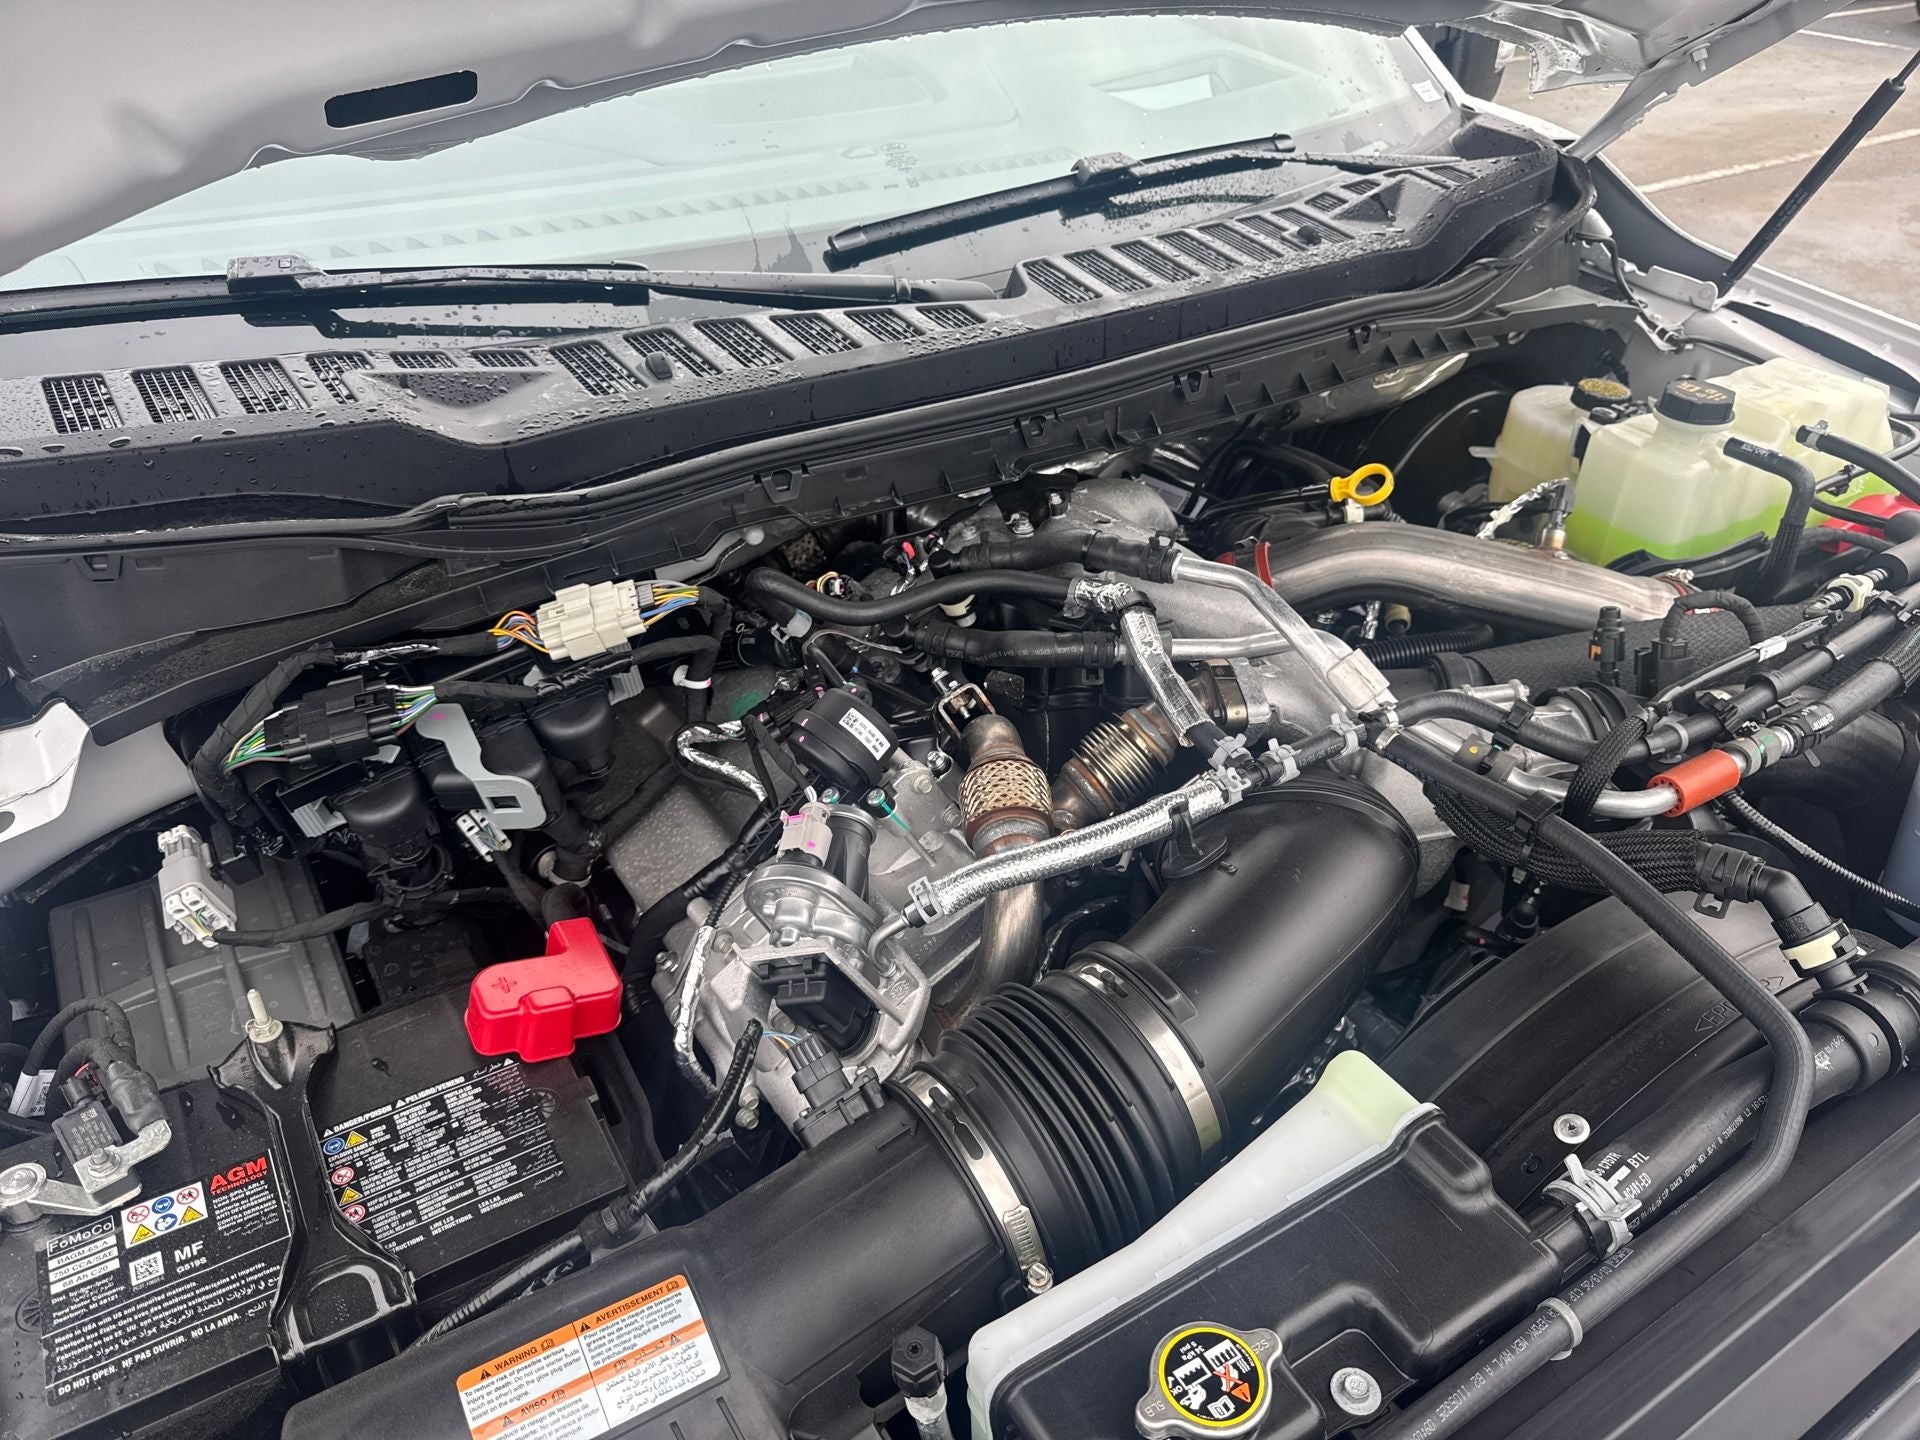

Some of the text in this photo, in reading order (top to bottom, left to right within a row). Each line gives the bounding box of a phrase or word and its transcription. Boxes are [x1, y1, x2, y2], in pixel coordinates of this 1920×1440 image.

[333, 1104, 392, 1132] DANGER/POISON
[404, 1075, 465, 1104] PELIGRO/VENENO
[1626, 1147, 1649, 1170] BTL
[210, 1156, 268, 1191] AGM
[211, 1168, 267, 1197] TECHNOLOGY
[212, 1178, 265, 1205] NON-SPILLABLE
[213, 1182, 268, 1209] Lead Acid Battery
[216, 1211, 230, 1220] ANTI
[217, 1198, 276, 1227] CONTRA DERRAMES
[49, 1217, 111, 1254] FoMoCo
[53, 1248, 114, 1279] 750 CCA/SAE
[57, 1238, 108, 1266] BAGM-65-A
[173, 1239, 204, 1263] MF
[62, 1263, 108, 1287] 68 Ah C20
[52, 1306, 69, 1318] Ford
[70, 1298, 90, 1310] Motor
[54, 1331, 73, 1344] Made
[82, 1321, 96, 1332] USA
[97, 1315, 111, 1326] with
[112, 1310, 122, 1319] US
[123, 1305, 135, 1314] and
[136, 1291, 165, 1310] imported
[89, 1302, 98, 1310] MI
[134, 1310, 148, 1320] avec
[150, 1304, 161, 1313] des
[584, 1330, 598, 1340] Pour
[598, 1320, 619, 1333] réduire
[626, 1308, 646, 1321] risque
[653, 1291, 681, 1307] blessures
[594, 1287, 664, 1323] AVERTISSEMENT
[93, 1338, 102, 1347] en
[103, 1333, 113, 1342] los
[139, 1318, 151, 1328] con
[586, 1334, 606, 1347] graves
[663, 1302, 674, 1310] pas
[587, 1340, 606, 1353] fluides
[606, 1336, 615, 1344] de
[614, 1322, 645, 1341] démarrage
[590, 1350, 604, 1359] avec
[612, 1336, 632, 1349] moteur
[659, 1312, 682, 1327] bougies
[58, 1310, 241, 1396] DO NOT OPEN. NE PAS OUVRIR. NO LA ABRA.
[494, 1345, 537, 1371] WARNING
[1181, 1344, 1204, 1362] 34 kPa
[464, 1346, 565, 1398] To reduce risk of possible serious
[466, 1393, 485, 1406] injury
[493, 1379, 513, 1392] death:
[513, 1374, 523, 1383] Do
[523, 1369, 533, 1378] not
[534, 1364, 545, 1373] use
[545, 1355, 563, 1367] starter
[563, 1348, 579, 1359] fluids
[468, 1401, 485, 1413] (such
[486, 1397, 494, 1405] as
[512, 1382, 525, 1392] with
[525, 1377, 535, 1386] the
[535, 1370, 550, 1382] glow
[549, 1364, 563, 1375] plug
[563, 1355, 581, 1368] starter
[1169, 1384, 1182, 1395] OK
[470, 1409, 488, 1421] assist
[498, 1399, 508, 1408] the
[509, 1389, 531, 1403] engine.
[519, 1397, 548, 1416] AVISO
[519, 1396, 582, 1431] el riesgo de lesiones
[579, 1402, 589, 1411] de
